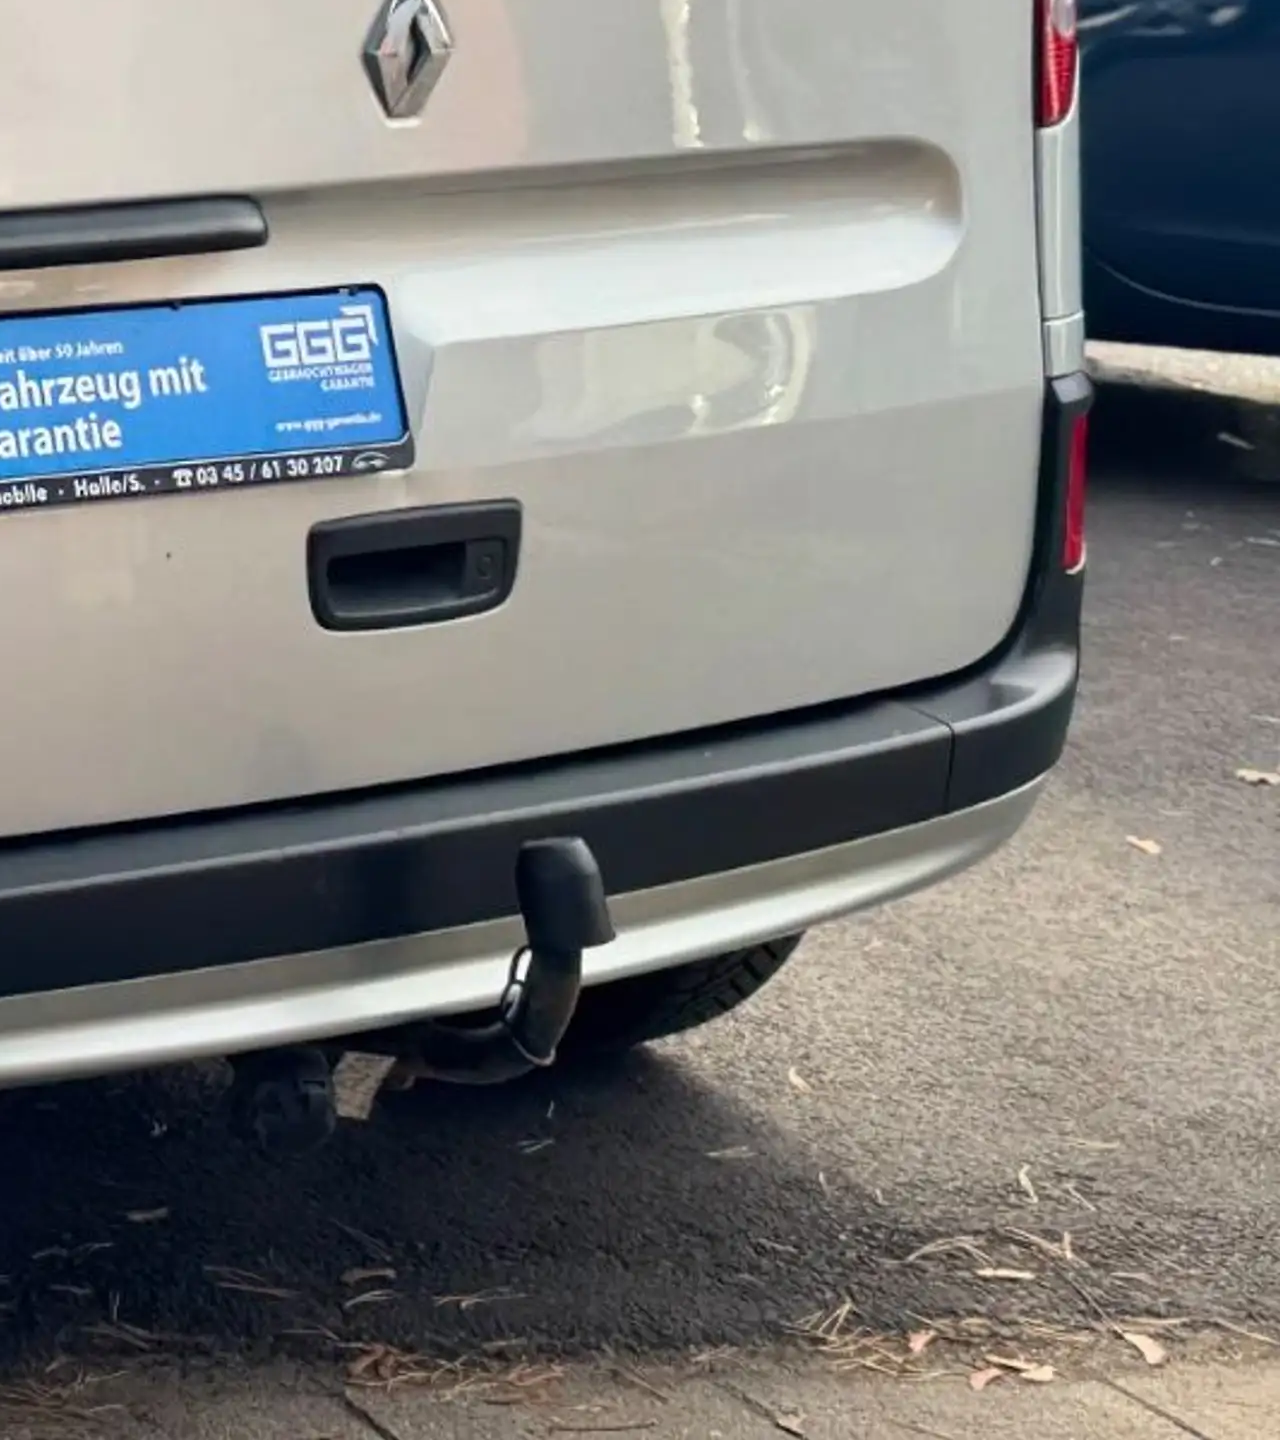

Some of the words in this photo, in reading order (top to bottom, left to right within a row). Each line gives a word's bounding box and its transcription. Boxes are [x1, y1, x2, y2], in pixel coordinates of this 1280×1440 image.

[18, 344, 52, 362] über
[54, 342, 74, 358] 50
[76, 339, 124, 357] Jahren
[260, 315, 374, 368] GGG
[148, 355, 208, 398] mit
[73, 471, 146, 498] Halle/S.
[196, 465, 218, 485] 03
[222, 463, 243, 483] 45
[261, 459, 281, 479] 61
[286, 457, 309, 477] 30
[312, 455, 344, 475] 207
